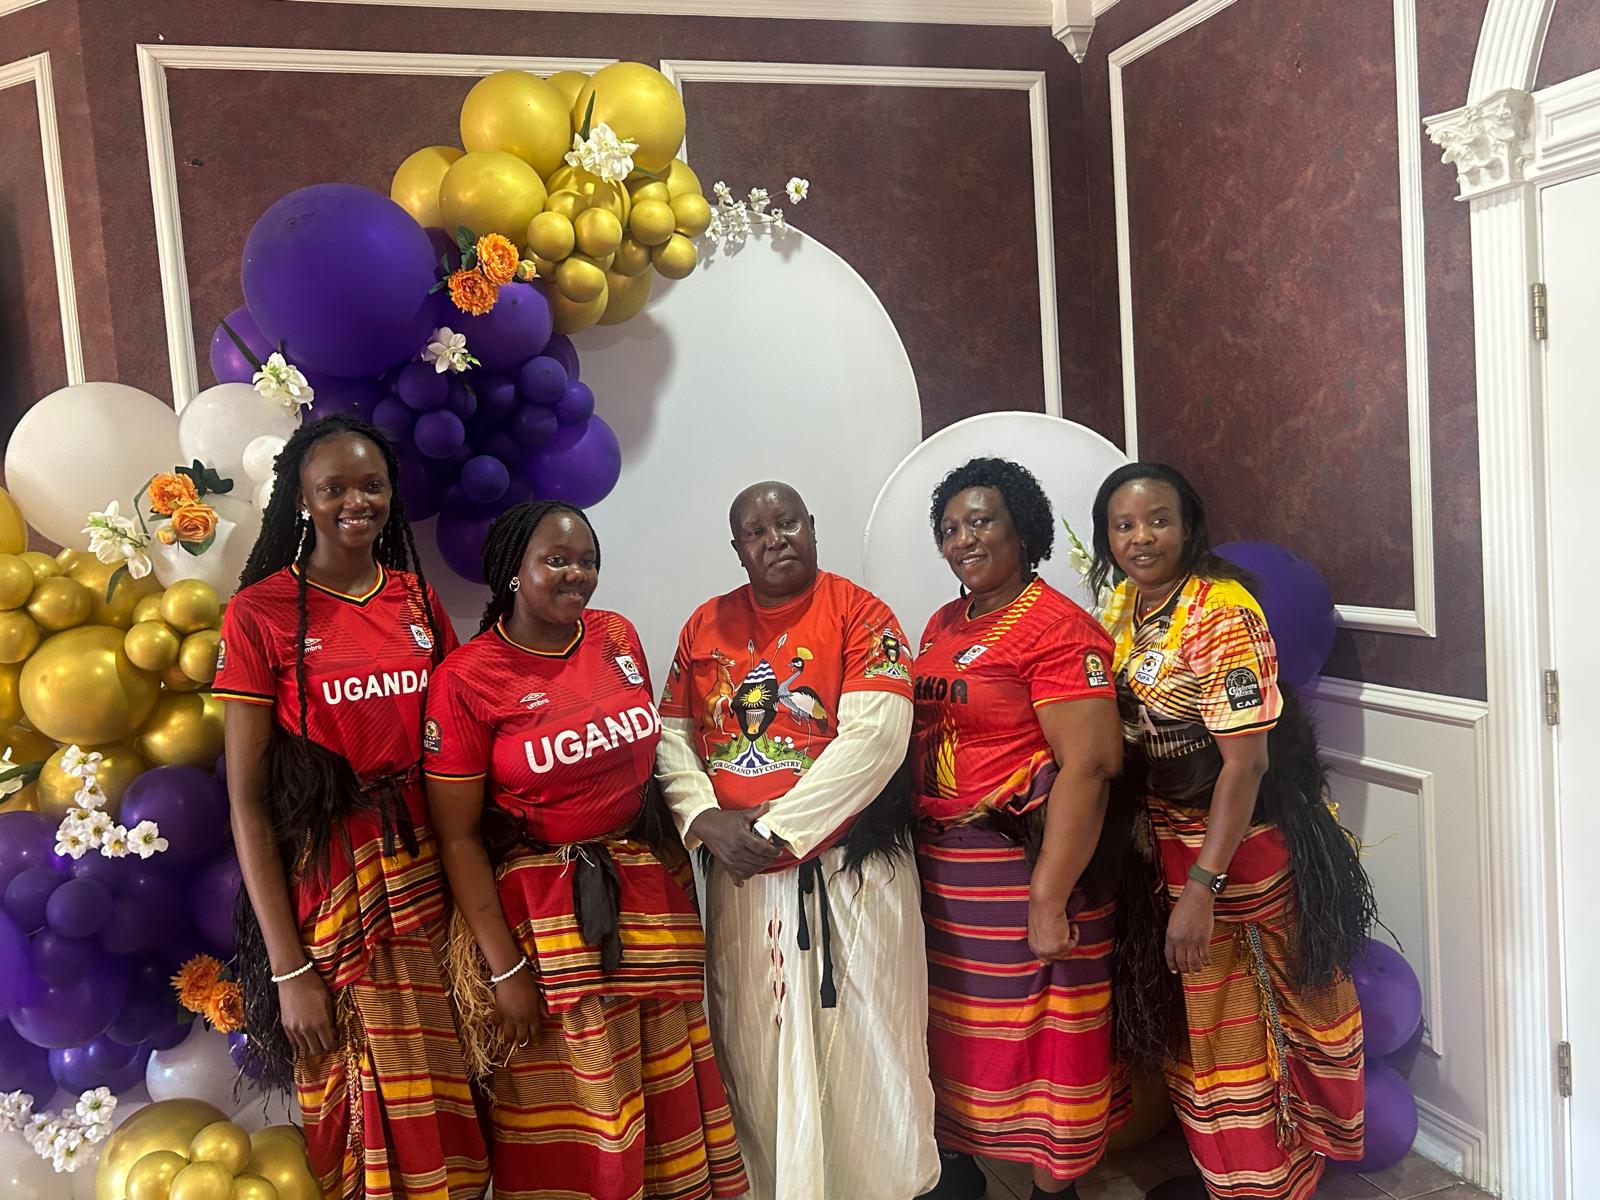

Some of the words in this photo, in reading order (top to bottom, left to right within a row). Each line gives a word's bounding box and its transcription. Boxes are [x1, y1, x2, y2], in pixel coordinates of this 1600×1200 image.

[304, 645, 322, 653] mbro
[323, 669, 428, 705] UGANDA
[527, 699, 550, 710] umbro
[1236, 699, 1260, 709] CAF
[524, 702, 662, 774] UGANDA
[724, 763, 737, 771] GOD
[736, 767, 752, 775] AND
[752, 767, 764, 775] MY
[765, 761, 800, 771] COUNTRY
